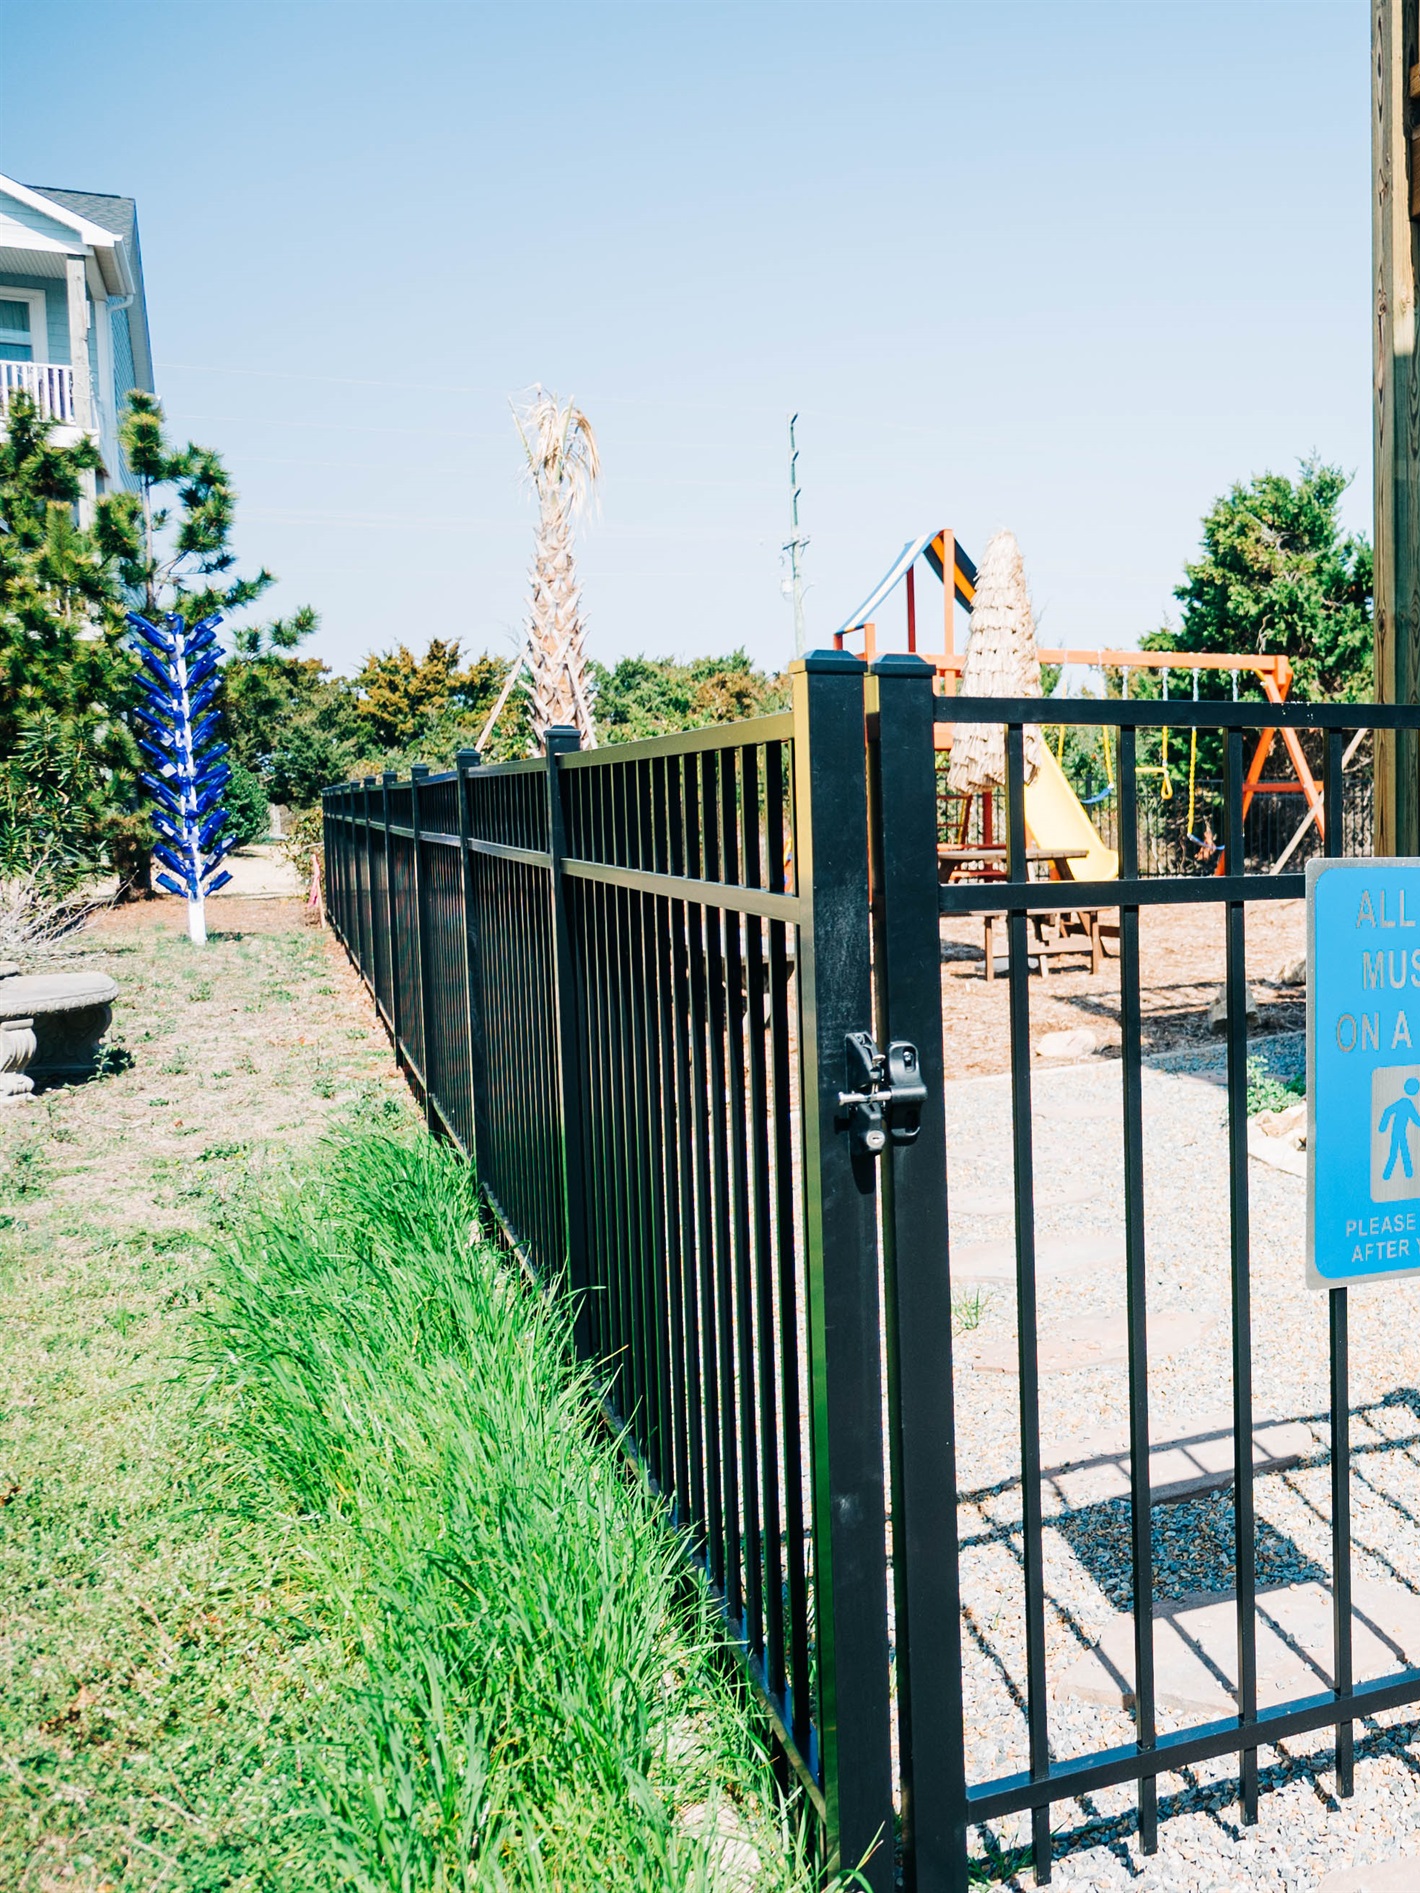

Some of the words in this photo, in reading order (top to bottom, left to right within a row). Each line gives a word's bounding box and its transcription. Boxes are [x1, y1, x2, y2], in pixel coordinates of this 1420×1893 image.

[1356, 889, 1416, 929] ALL
[1335, 1011, 1380, 1052] ON
[1390, 1010, 1413, 1050] A
[1345, 1213, 1416, 1238] PLEASE
[1351, 1239, 1410, 1263] AFTER
